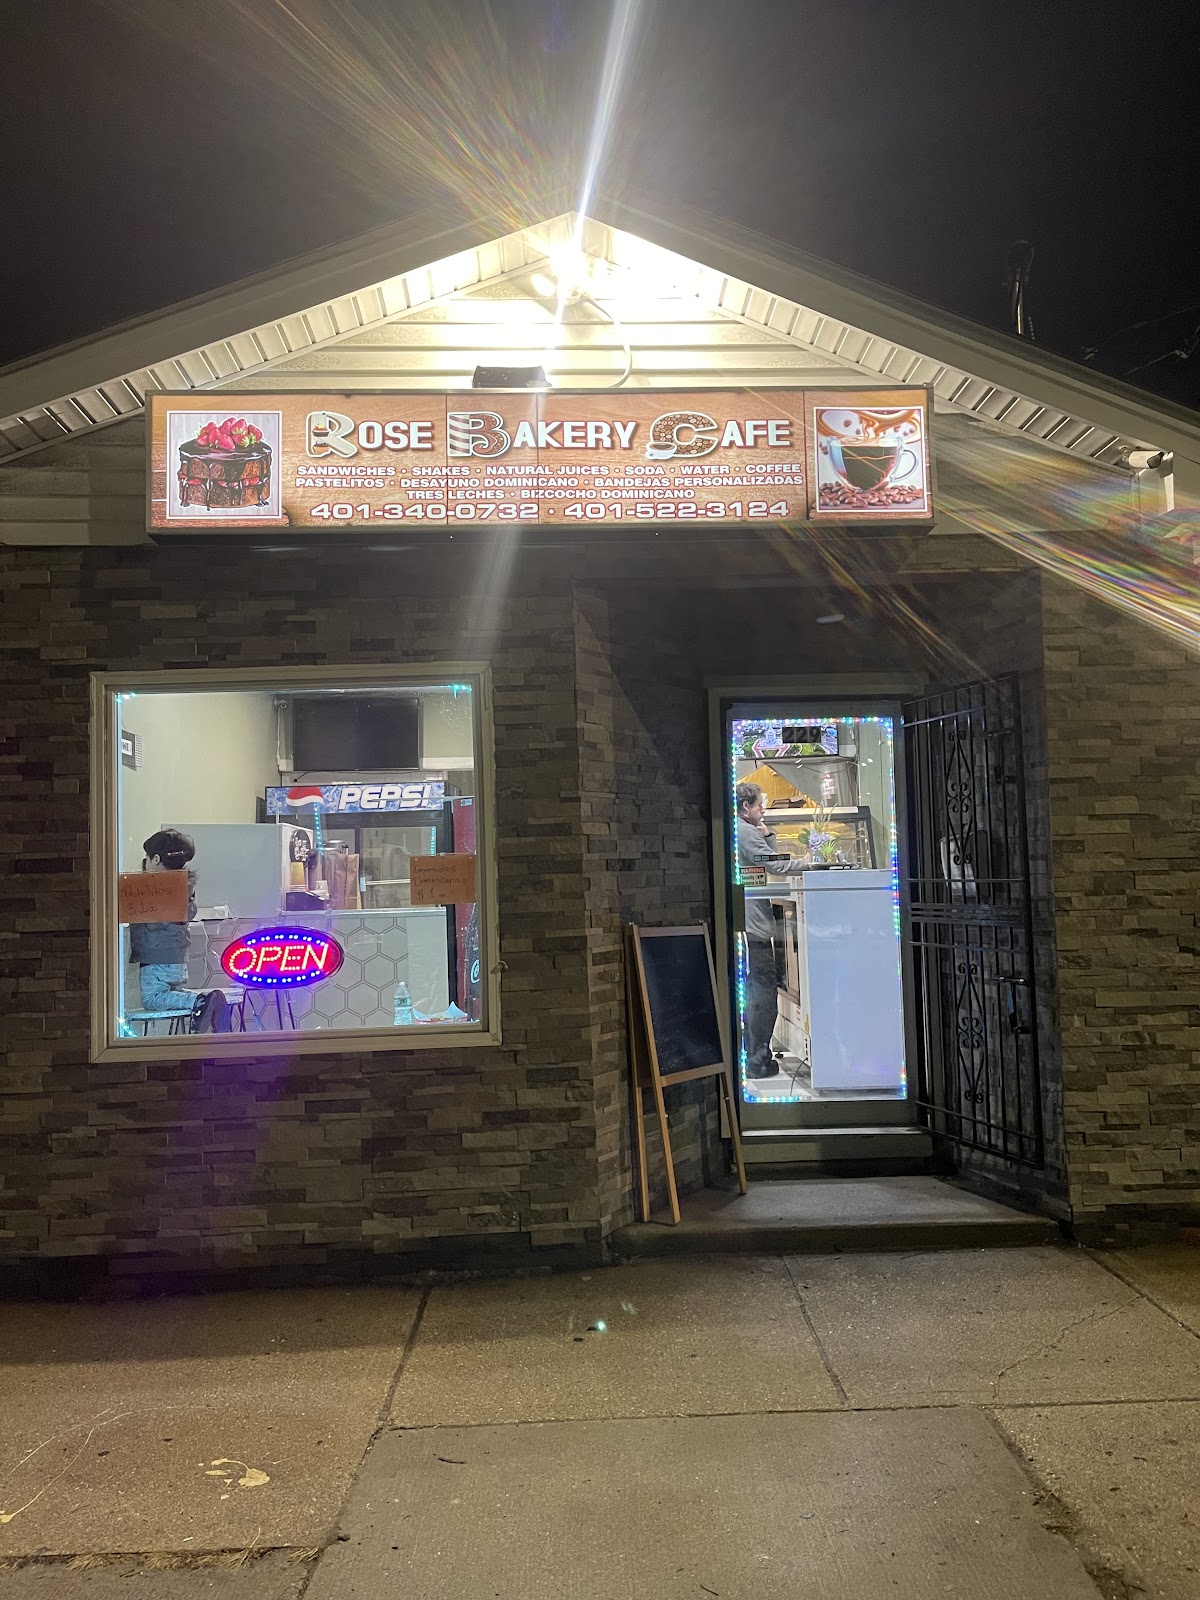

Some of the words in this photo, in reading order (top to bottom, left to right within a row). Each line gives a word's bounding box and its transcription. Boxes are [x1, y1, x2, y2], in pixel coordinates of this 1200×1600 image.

[306, 411, 434, 458] ROSE
[447, 411, 637, 458] BAKERY
[647, 410, 792, 459] CAFE
[297, 465, 396, 477] SANDWICHES
[411, 466, 470, 476] SHAKES
[486, 465, 553, 476] NATURAL
[556, 465, 610, 476] JUICES
[624, 465, 665, 475] SODA
[680, 465, 730, 475] WATER
[745, 463, 801, 474] COFFEE
[295, 477, 385, 488] PASTELITOS
[400, 477, 480, 488] DESAYUNO
[484, 477, 579, 488] DOMINICANO
[594, 477, 671, 487] BANDEJAS
[674, 475, 803, 487] PERSONALIZADAS
[406, 490, 444, 500] TRES
[448, 489, 505, 500] LECHES
[520, 489, 597, 499] BIZCOCHO
[601, 488, 696, 499] DOMINICANO
[310, 502, 539, 520] 401-340-0732
[564, 500, 790, 519] 401-522-3124
[782, 727, 820, 742] 229
[338, 784, 433, 811] PEPSI
[229, 944, 329, 974] OPEN
